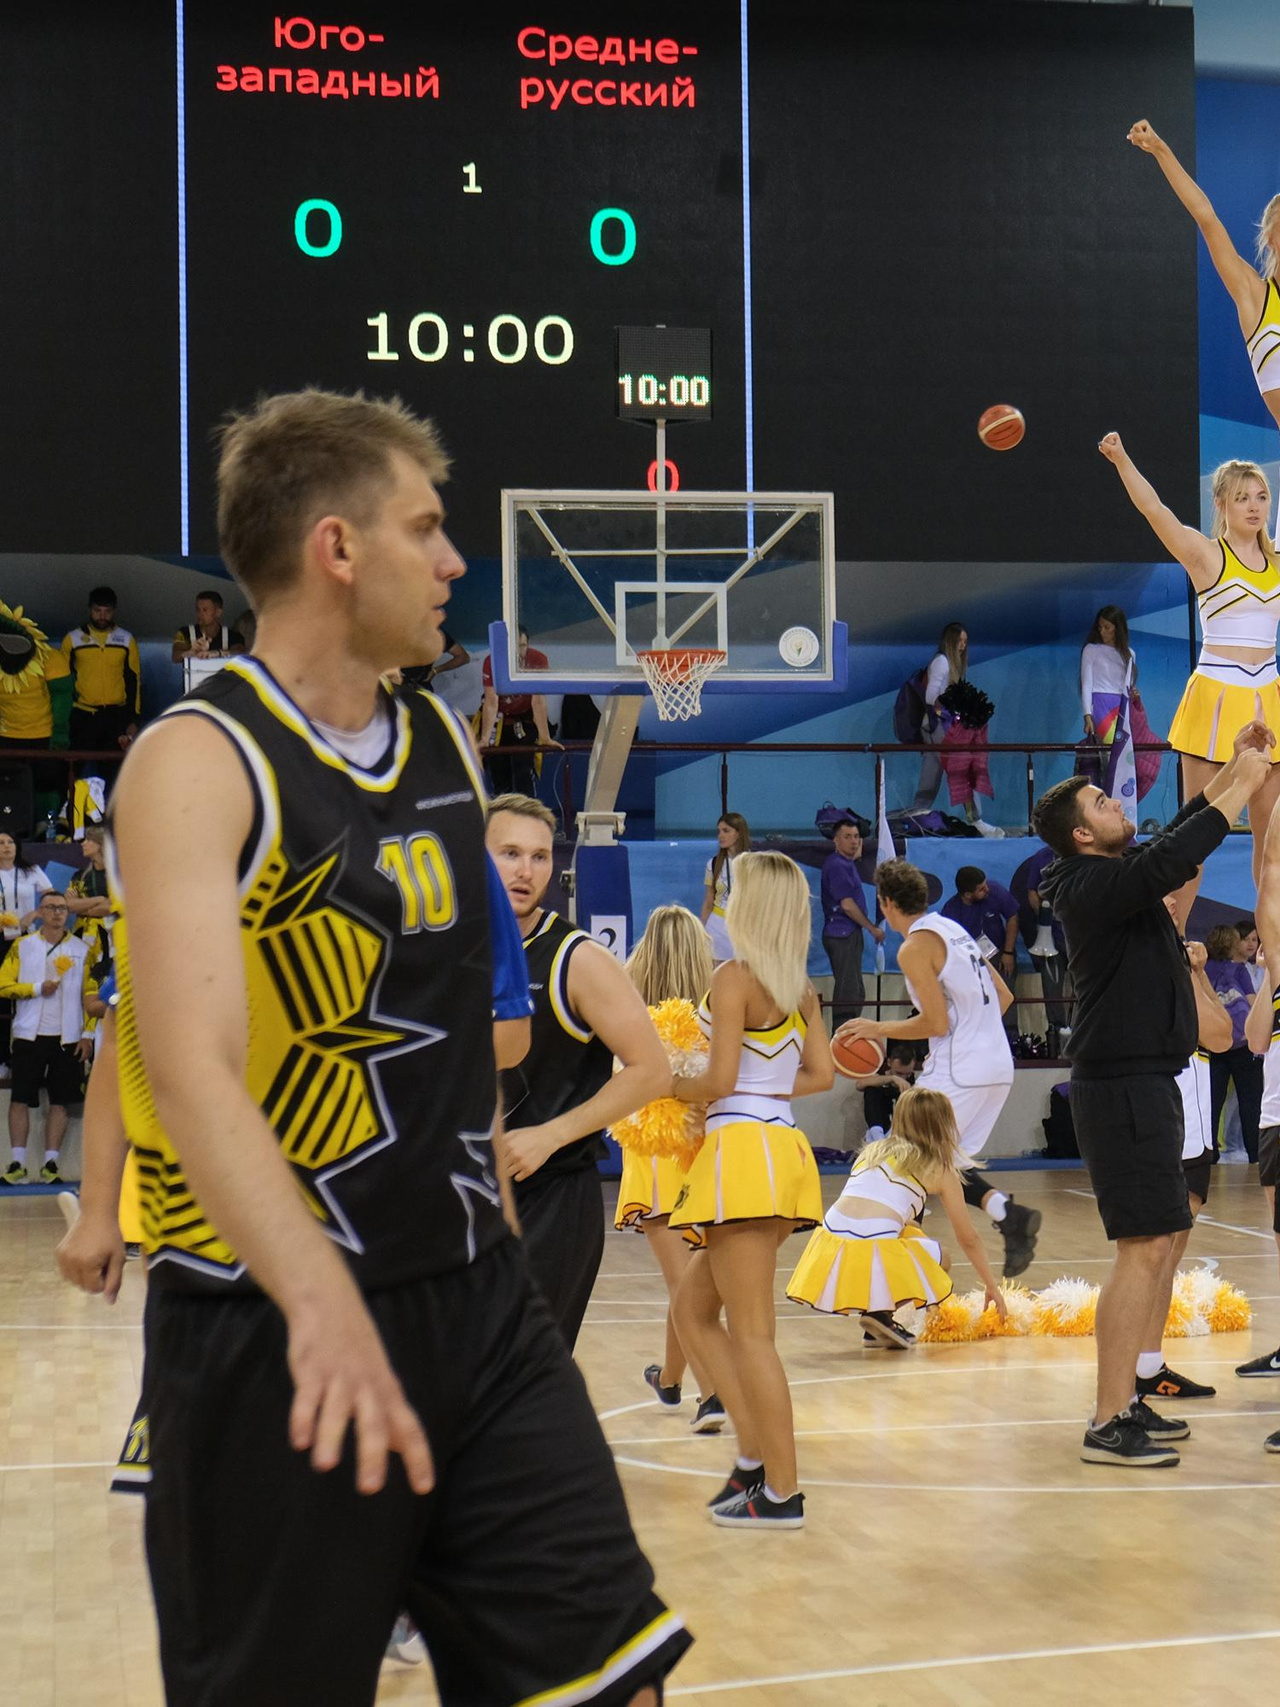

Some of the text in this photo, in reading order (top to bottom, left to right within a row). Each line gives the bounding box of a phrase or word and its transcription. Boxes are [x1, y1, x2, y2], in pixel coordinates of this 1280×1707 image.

[273, 16, 385, 52] Юго-
[516, 26, 698, 67] Средне-
[215, 65, 440, 99] западный
[519, 76, 696, 111] русский
[462, 162, 483, 193] 1
[294, 198, 343, 258] 0
[589, 207, 637, 266] 0
[366, 312, 574, 365] 10:00
[618, 374, 710, 407] 10:00
[374, 830, 459, 936] 10
[598, 927, 618, 957] 2
